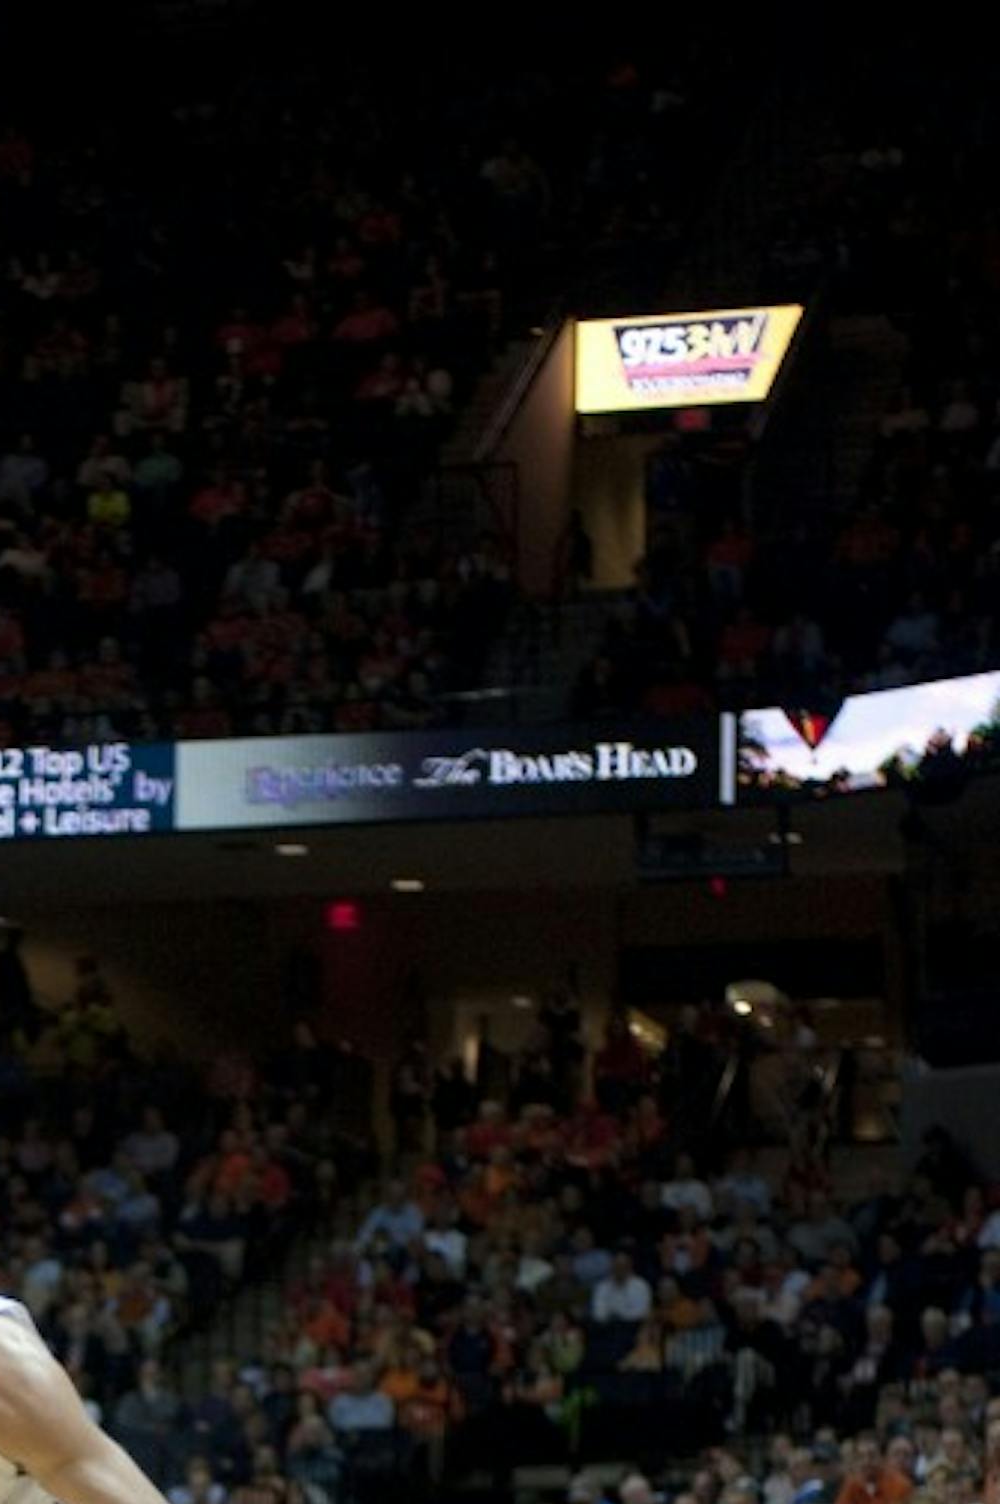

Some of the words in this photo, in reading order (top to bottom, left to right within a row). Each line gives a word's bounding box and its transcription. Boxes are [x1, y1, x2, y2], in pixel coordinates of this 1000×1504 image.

[27, 747, 84, 780] Top
[87, 743, 131, 773] US
[412, 748, 489, 787] The
[596, 742, 697, 781] HEAD
[134, 771, 173, 805] by
[19, 811, 41, 834] +
[45, 804, 151, 835] Leisure
